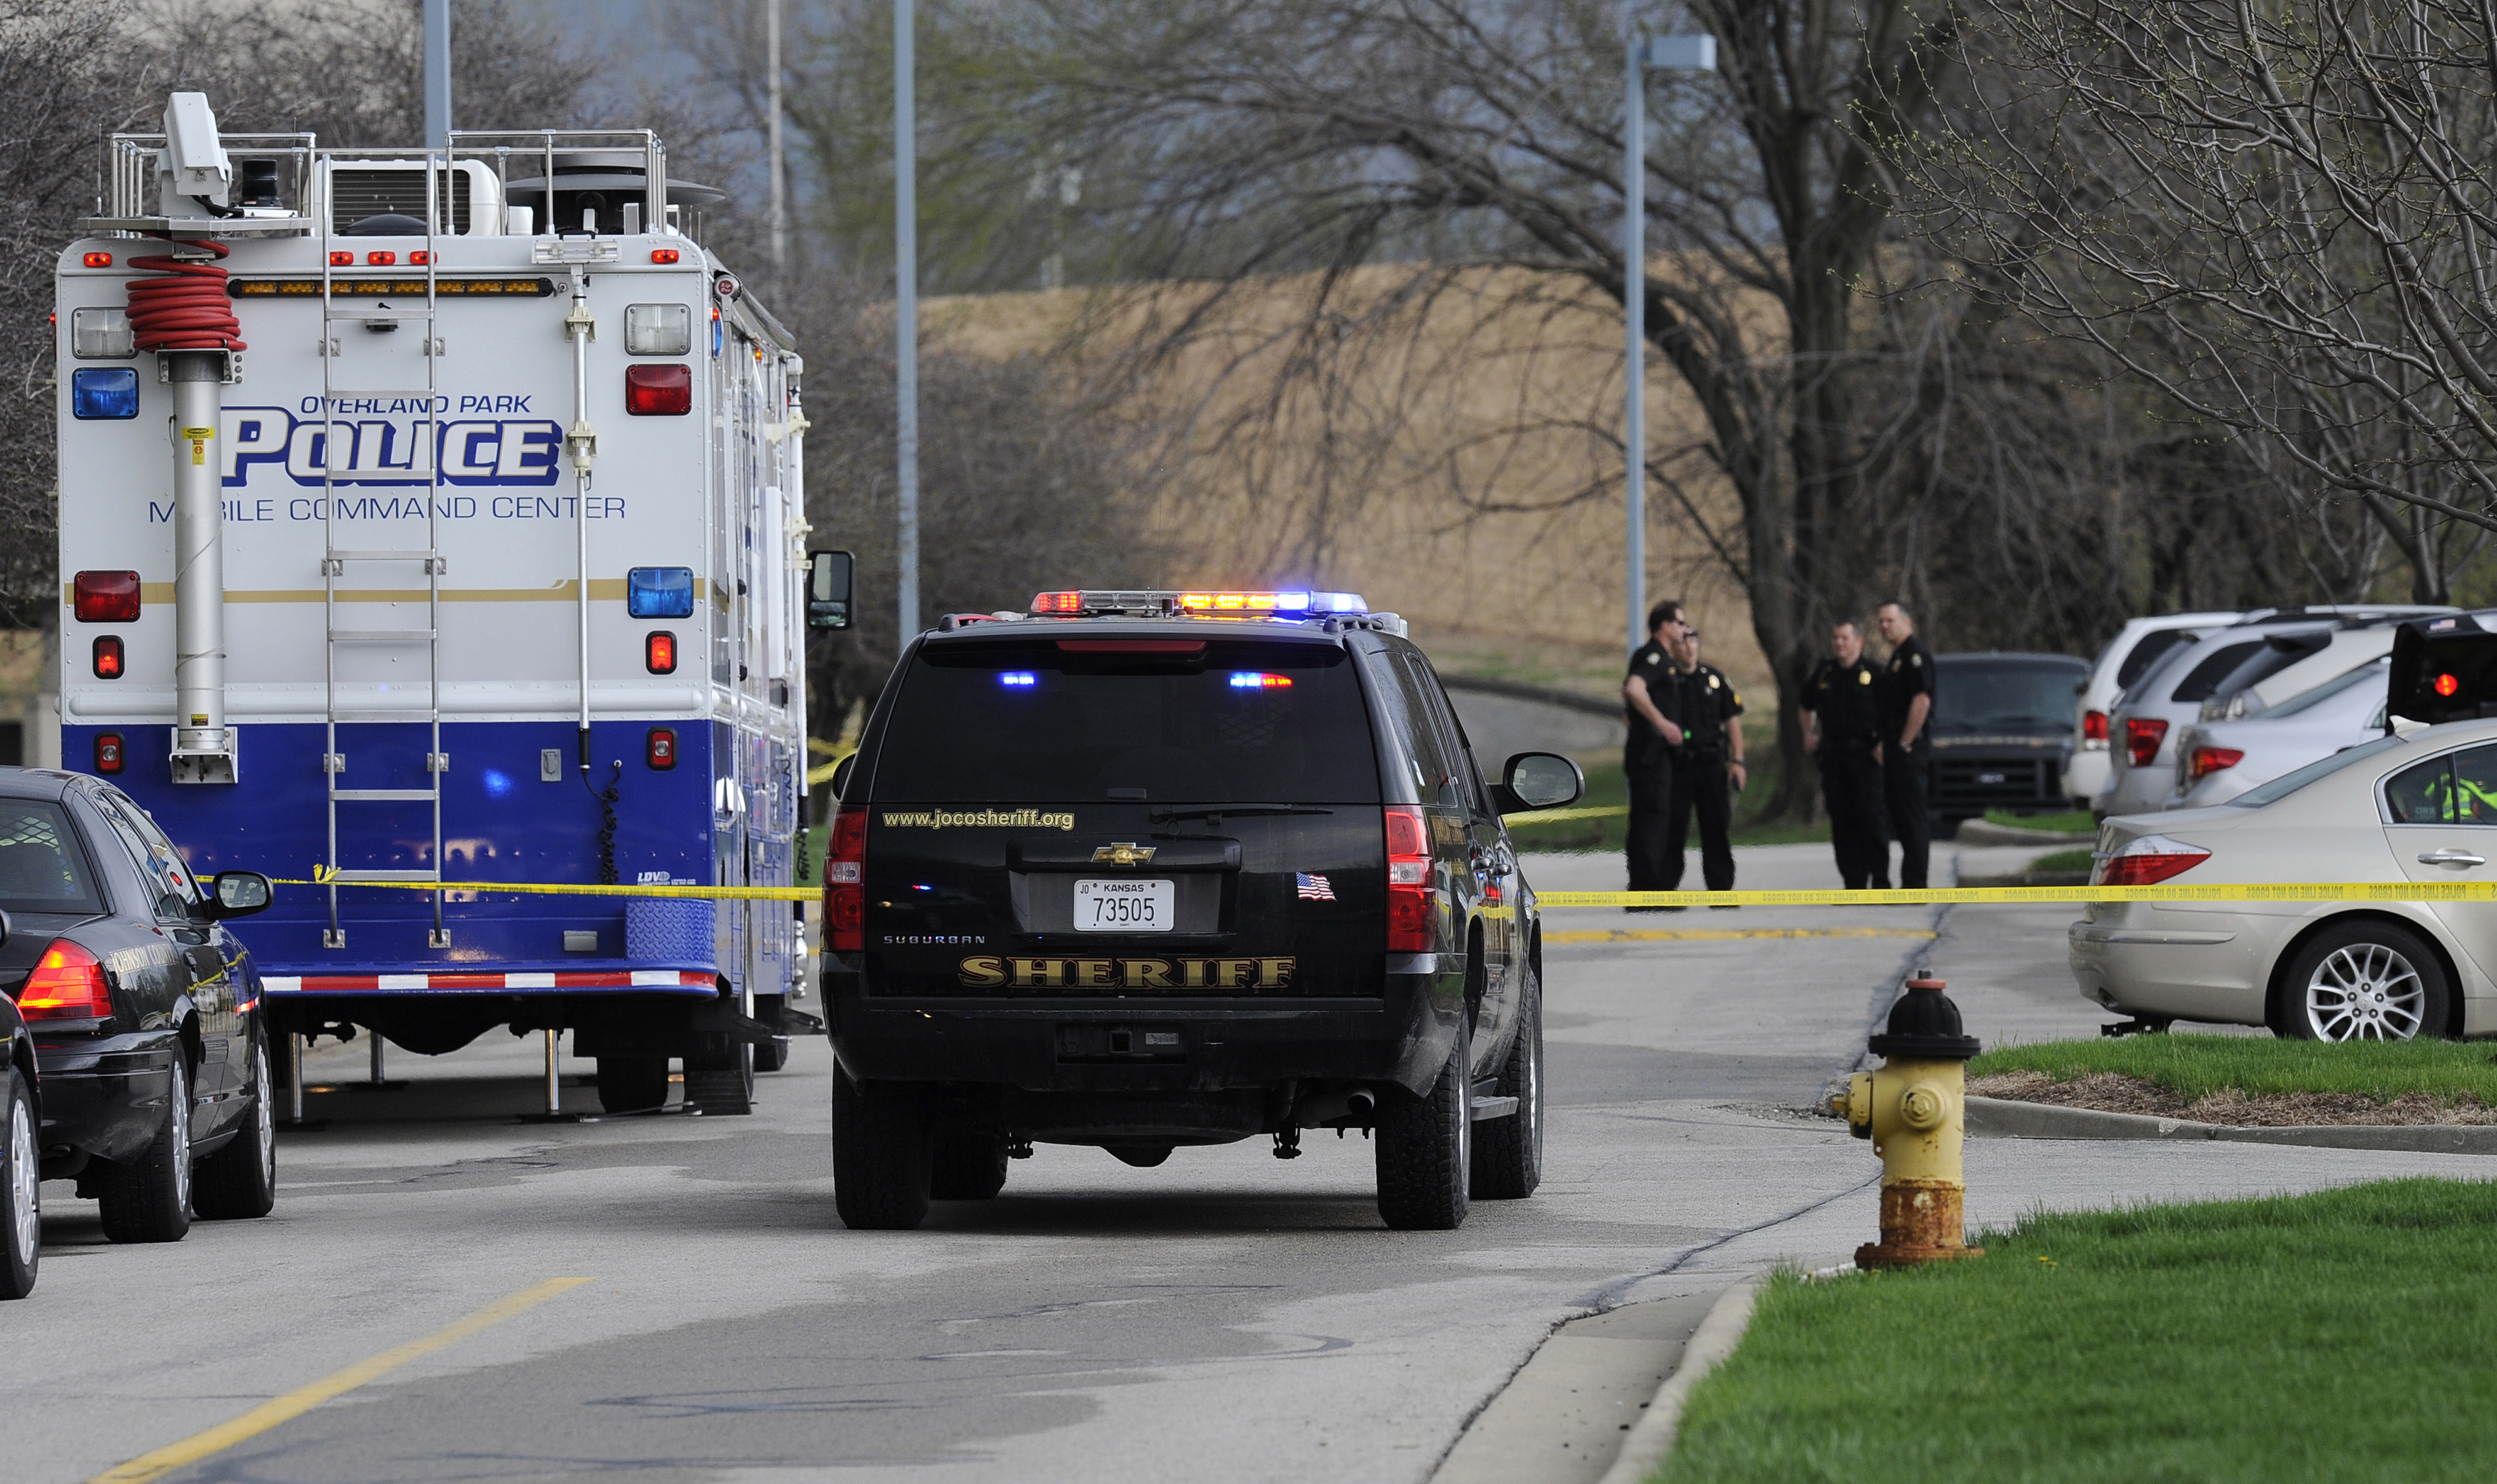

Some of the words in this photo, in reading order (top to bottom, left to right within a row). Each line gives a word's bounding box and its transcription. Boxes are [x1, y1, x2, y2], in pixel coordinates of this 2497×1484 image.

[459, 395, 532, 413] PARK
[220, 406, 563, 487] POLICE
[150, 499, 274, 523] MILE
[290, 497, 477, 521] COMMAND
[492, 497, 625, 519] CENTER
[883, 808, 1074, 830] www.jocosheriff.org
[1080, 884, 1089, 895] JO
[1104, 884, 1144, 893] KANSAS
[1093, 898, 1155, 922] 73505
[883, 935, 985, 944] SUBURBAN
[110, 945, 151, 980] JOHNSON
[957, 955, 1296, 990] SHERIFF
